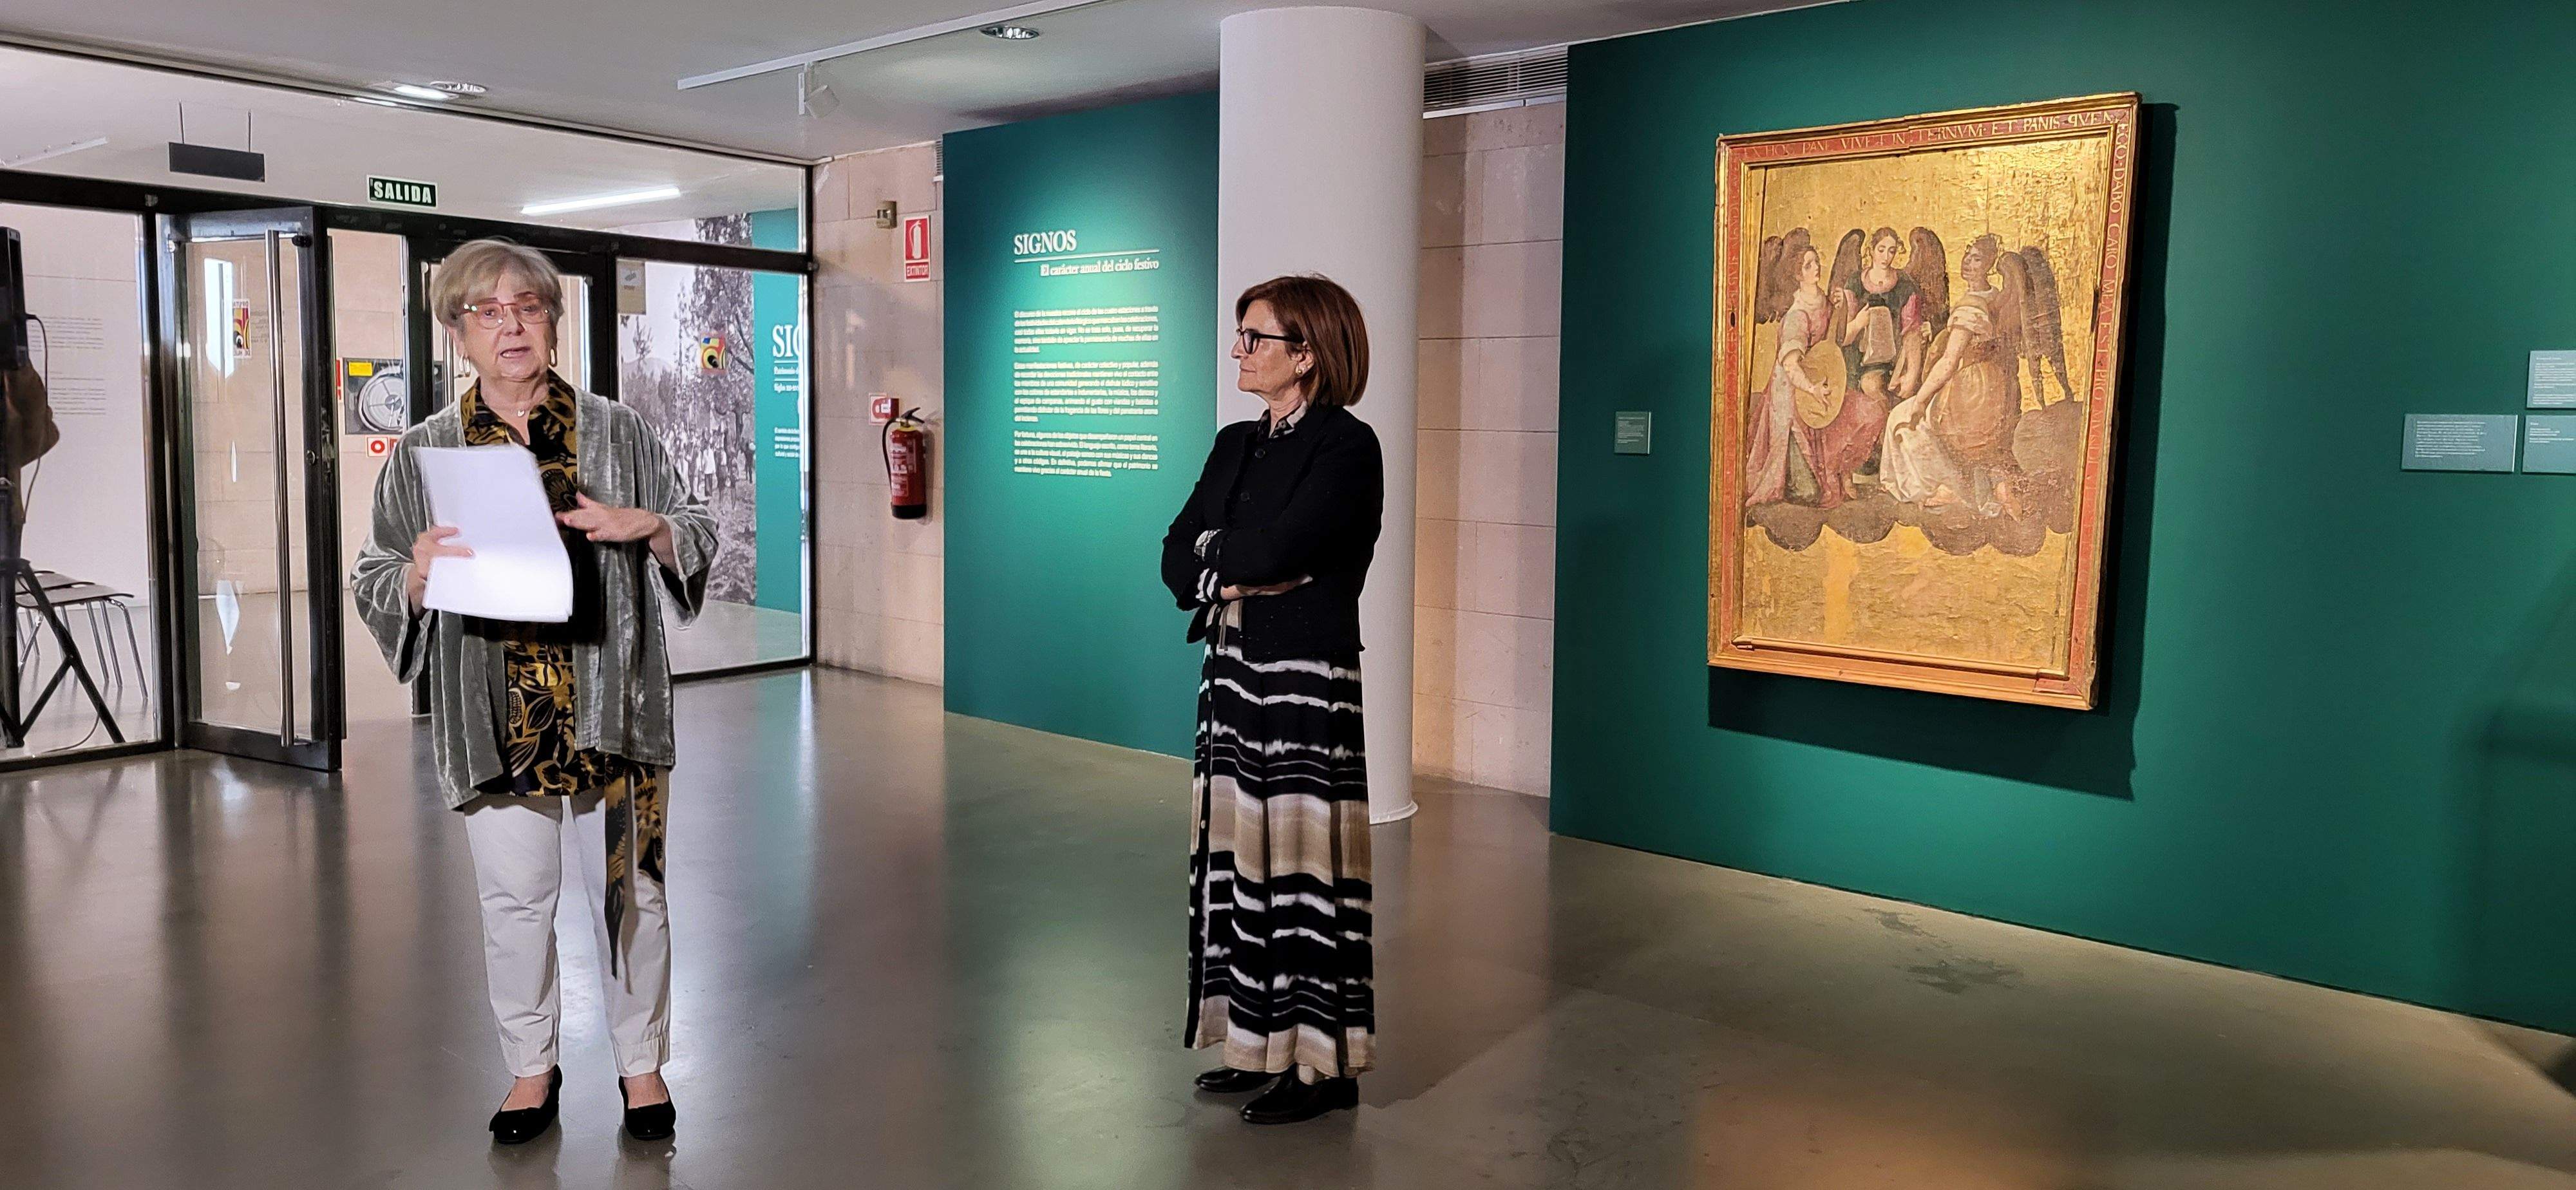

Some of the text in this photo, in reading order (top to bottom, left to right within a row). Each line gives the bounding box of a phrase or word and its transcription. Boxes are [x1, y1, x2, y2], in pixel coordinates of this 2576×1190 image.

[1991, 119, 2018, 135] ET
[2023, 116, 2060, 132] PANIS
[374, 182, 431, 203] SALIDA
[2110, 167, 2125, 213] DABO
[1014, 229, 1077, 255] SIGNOS
[2104, 223, 2120, 269] CARO
[1040, 256, 1159, 276] El carácter anual del ciclo festivo
